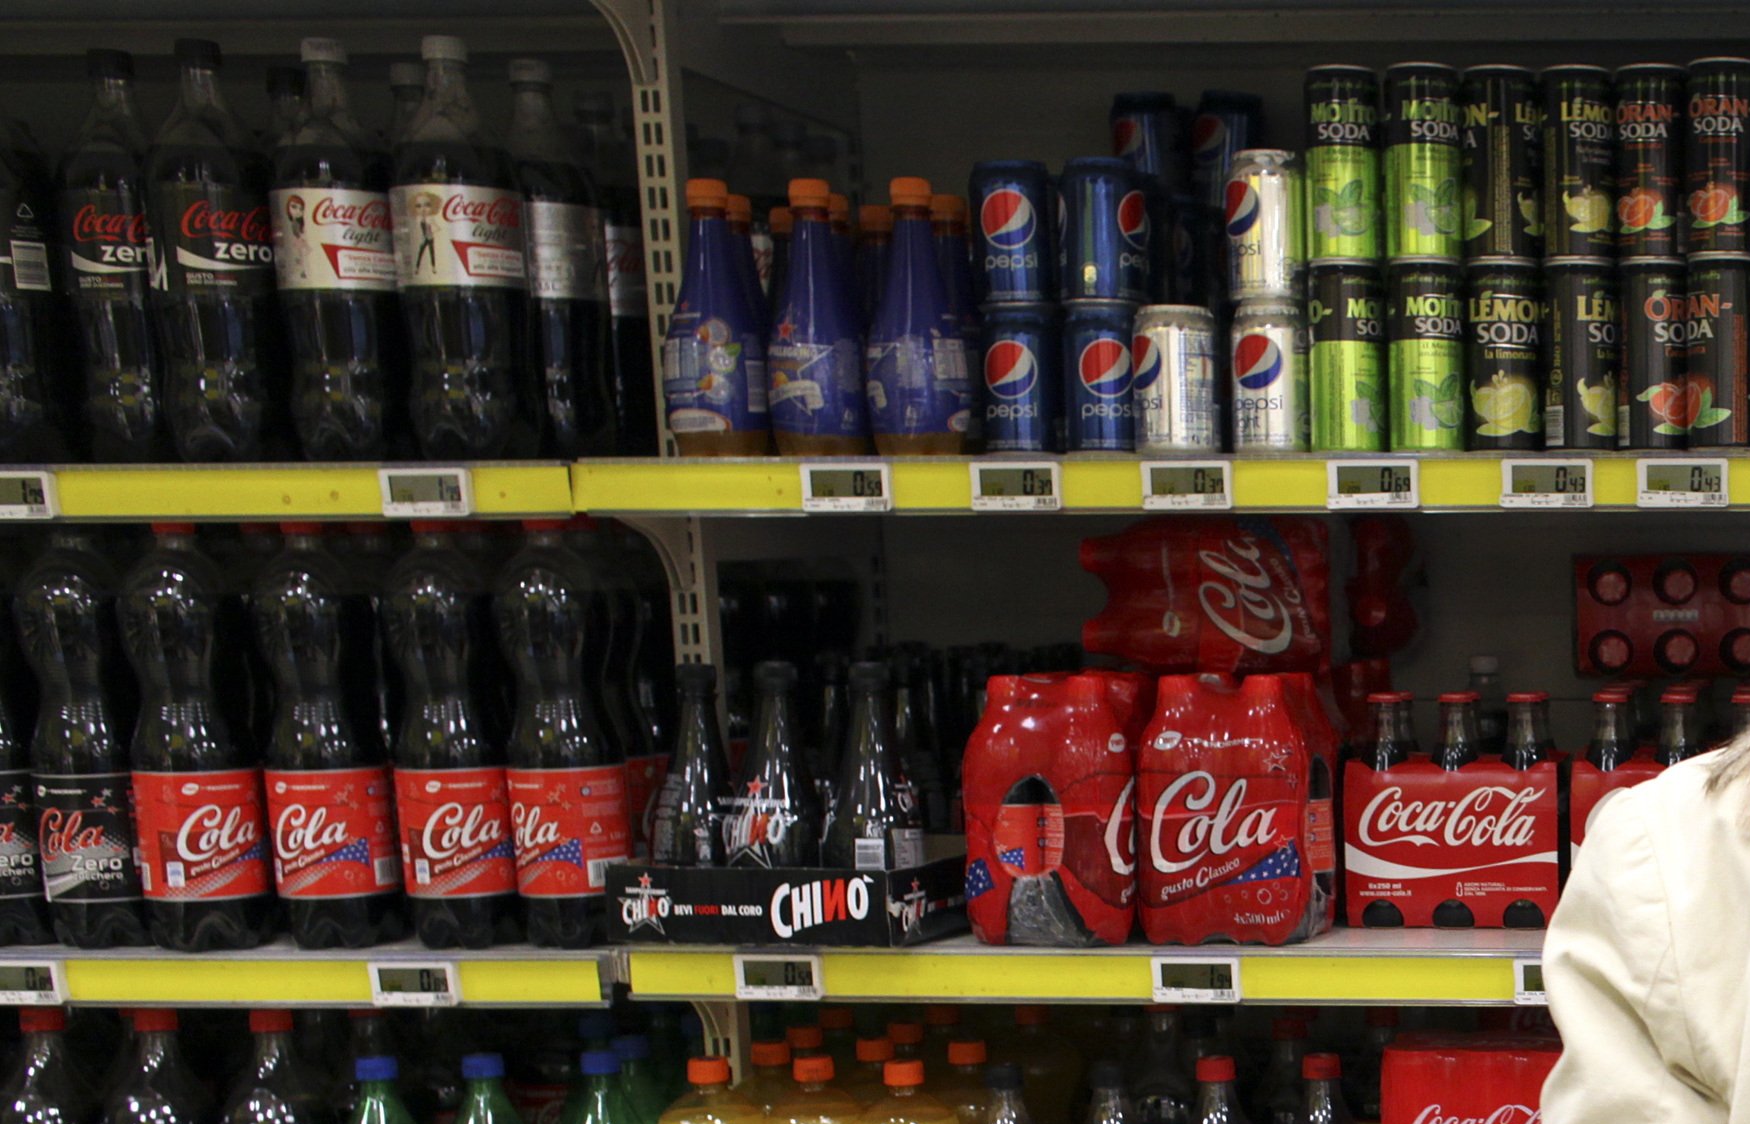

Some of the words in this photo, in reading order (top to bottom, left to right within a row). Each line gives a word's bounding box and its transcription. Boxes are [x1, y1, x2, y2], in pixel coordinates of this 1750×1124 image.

[1317, 121, 1371, 142] SODA
[1620, 121, 1668, 140] SODA
[1694, 115, 1745, 135] SODA
[342, 227, 381, 244] light
[101, 245, 147, 263] zer
[214, 240, 273, 261] zero
[985, 253, 1038, 272] pepsi
[1414, 316, 1462, 336] SODA
[1476, 322, 1539, 346] SODA
[1654, 321, 1714, 346] SODA
[986, 402, 1038, 421] pepsi
[1199, 533, 1293, 654] Cola
[1150, 770, 1277, 873] Cola
[1359, 785, 1547, 847] Coca-Cola
[39, 807, 105, 863] Cola
[177, 804, 256, 862] Cola
[276, 803, 348, 860] Cola
[422, 802, 500, 860] Cola
[721, 904, 736, 916] DAL
[738, 903, 763, 917] CORO
